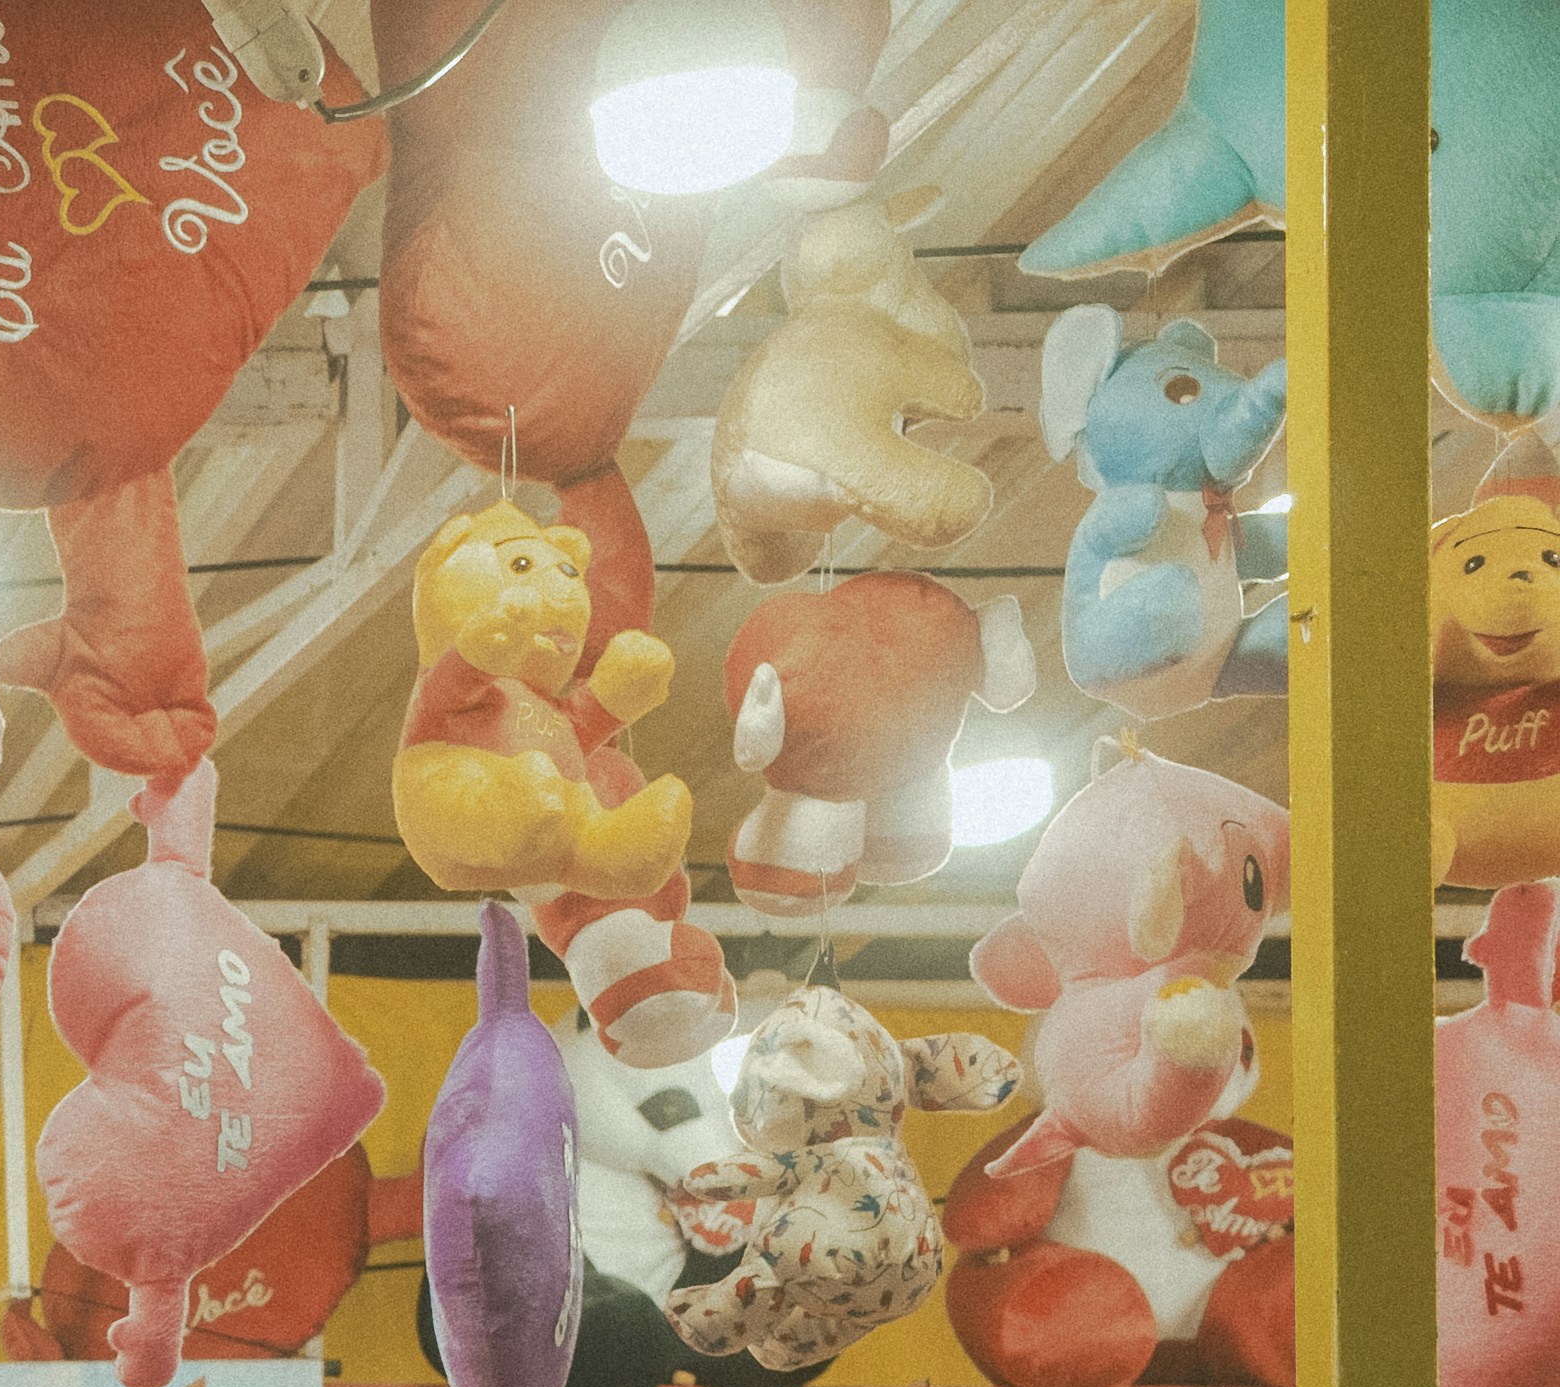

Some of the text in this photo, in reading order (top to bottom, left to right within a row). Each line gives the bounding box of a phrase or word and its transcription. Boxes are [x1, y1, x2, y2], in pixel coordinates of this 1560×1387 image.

[160, 46, 246, 258] Você
[1457, 707, 1551, 758] Puff
[179, 1033, 216, 1121] EU
[216, 947, 252, 1174] TE AMO
[1443, 1185, 1477, 1267] EU
[1480, 1091, 1525, 1316] TE AMO
